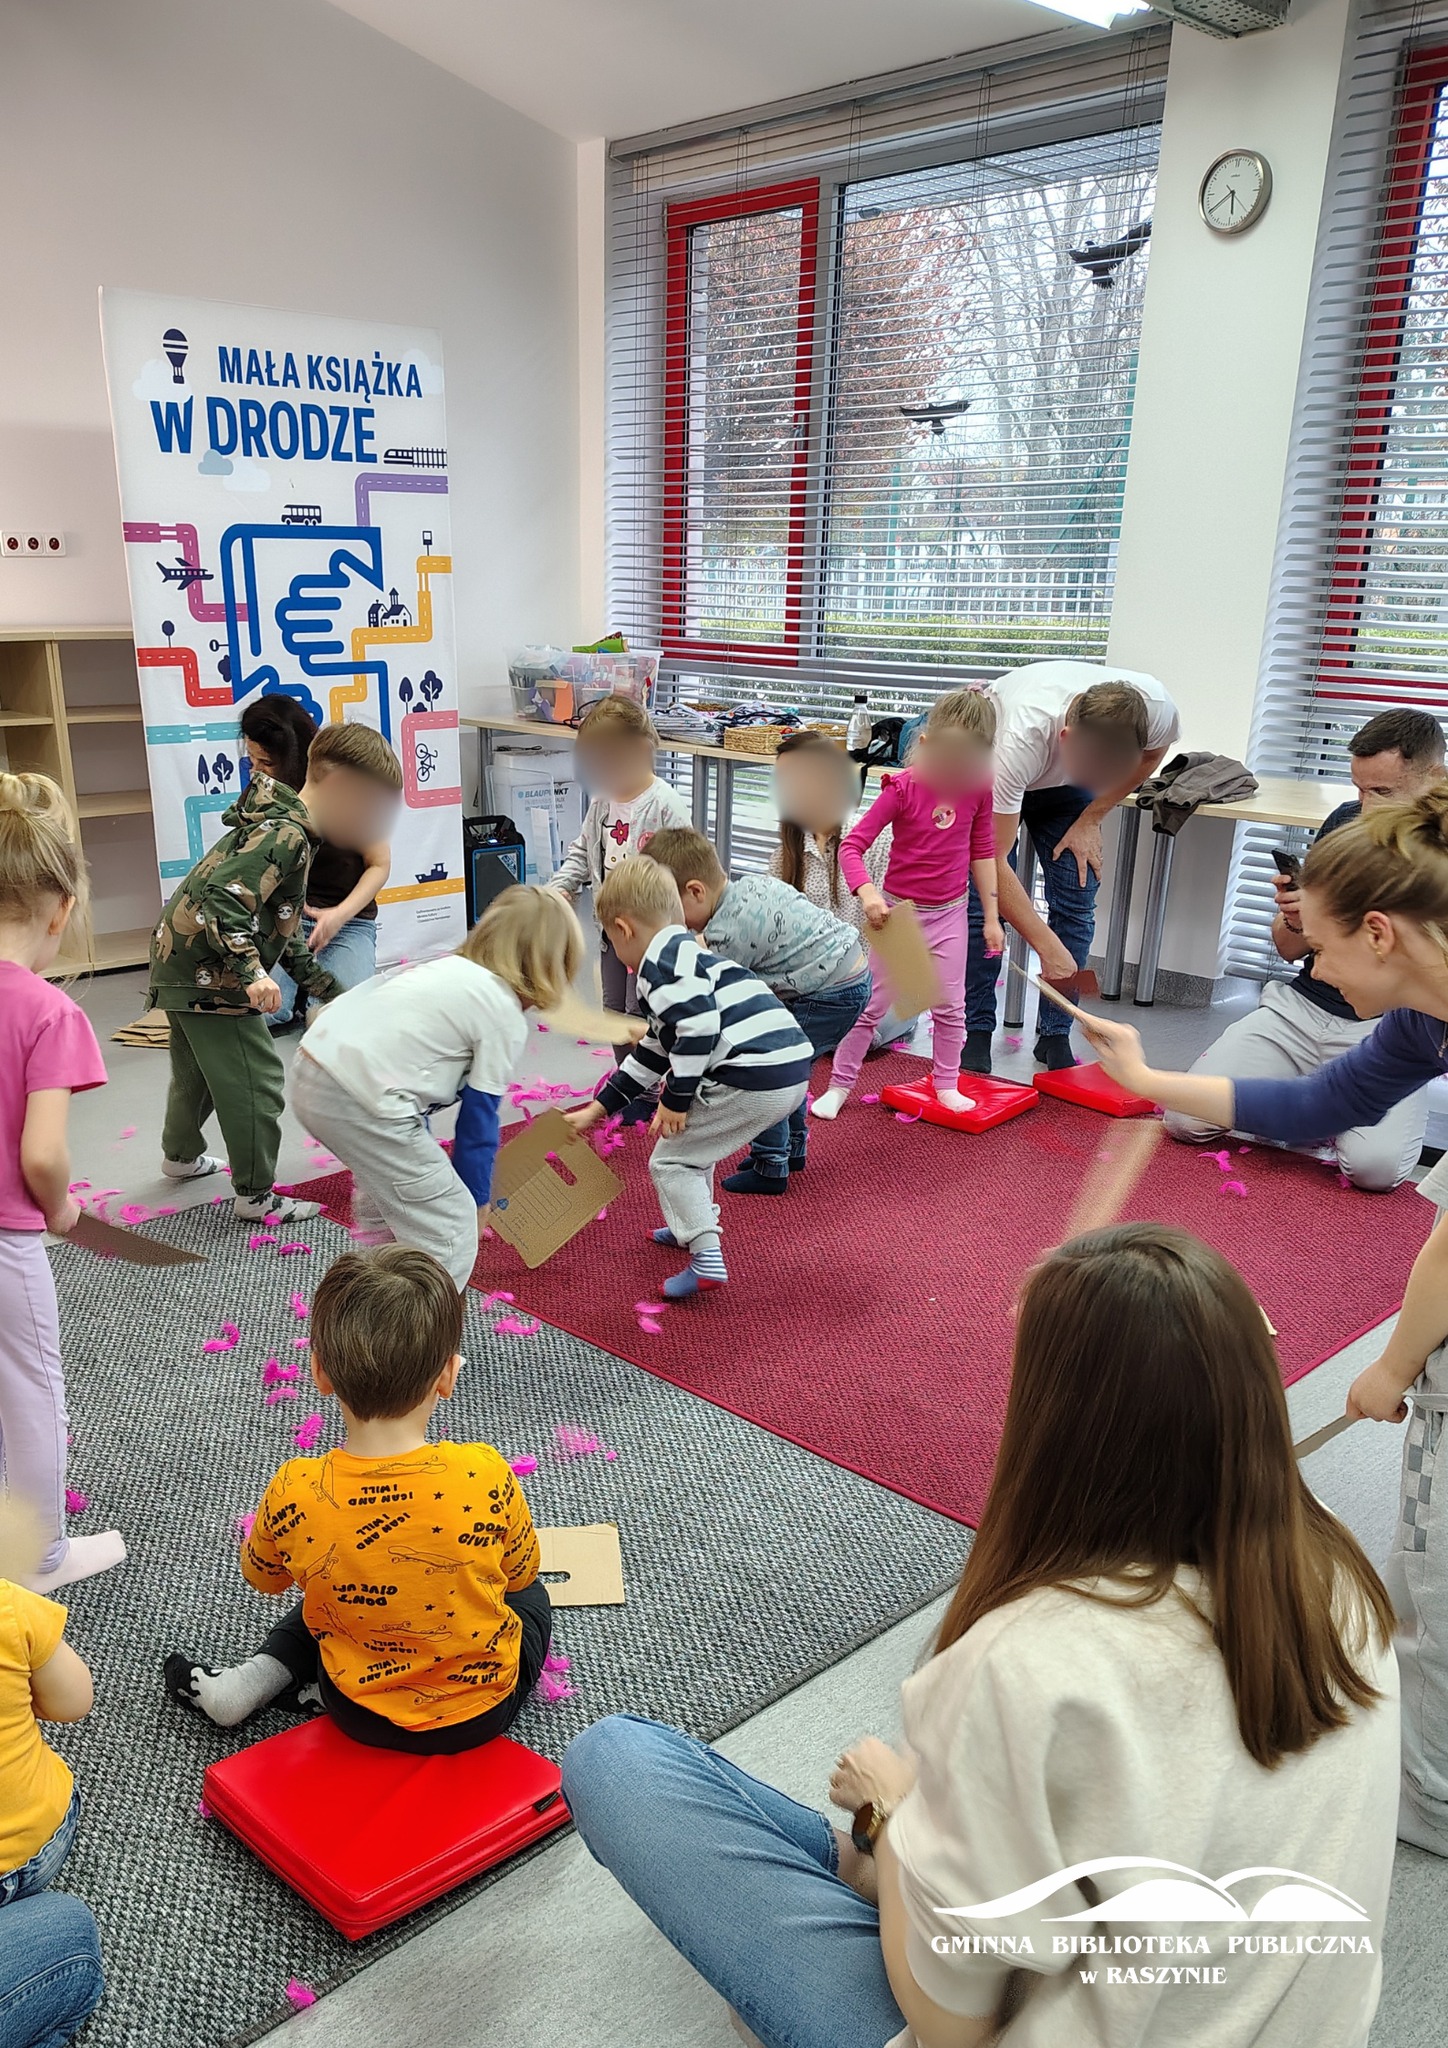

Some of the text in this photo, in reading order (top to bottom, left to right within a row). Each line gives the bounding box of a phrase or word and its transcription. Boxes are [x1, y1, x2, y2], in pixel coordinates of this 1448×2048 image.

[217, 345, 423, 404] MAŁA KSIĄŻKA
[150, 394, 378, 464] W DRODZE
[361, 1485, 391, 1494] WILL
[348, 1496, 377, 1506] AND
[270, 1503, 297, 1530] ON'T
[356, 1518, 385, 1535] WILL
[356, 1531, 380, 1550] AND
[458, 1533, 490, 1548] GIVE
[360, 1583, 398, 1596] GIVE
[337, 1593, 388, 1607] DON'T
[358, 1672, 381, 1684] AND
[481, 1672, 499, 1684] UP!
